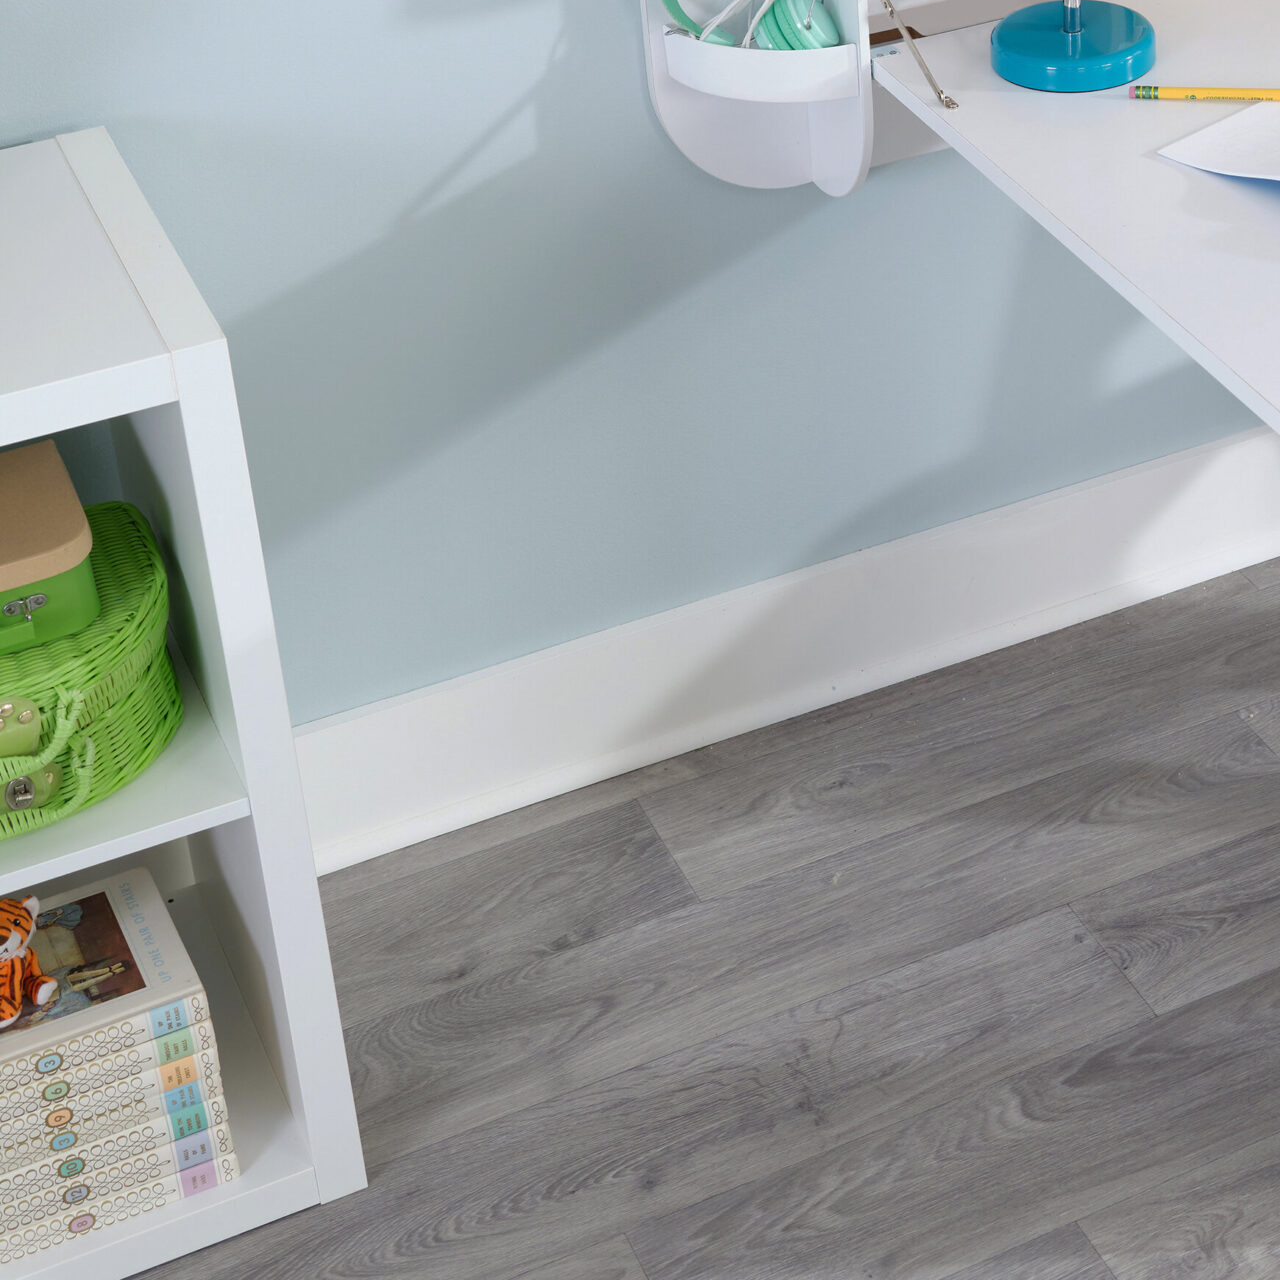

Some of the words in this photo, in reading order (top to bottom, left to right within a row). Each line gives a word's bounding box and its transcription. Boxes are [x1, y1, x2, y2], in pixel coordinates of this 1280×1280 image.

[120, 882, 140, 910] STAIRS
[132, 912, 145, 924] OF
[138, 926, 154, 946] PAIR
[148, 948, 165, 968] ONE
[158, 970, 172, 984] UP
[44, 1058, 56, 1069] 3
[58, 1138, 70, 1146] 3
[66, 1162, 78, 1176] 10
[70, 1188, 82, 1200] 12
[76, 1220, 88, 1228] 8
